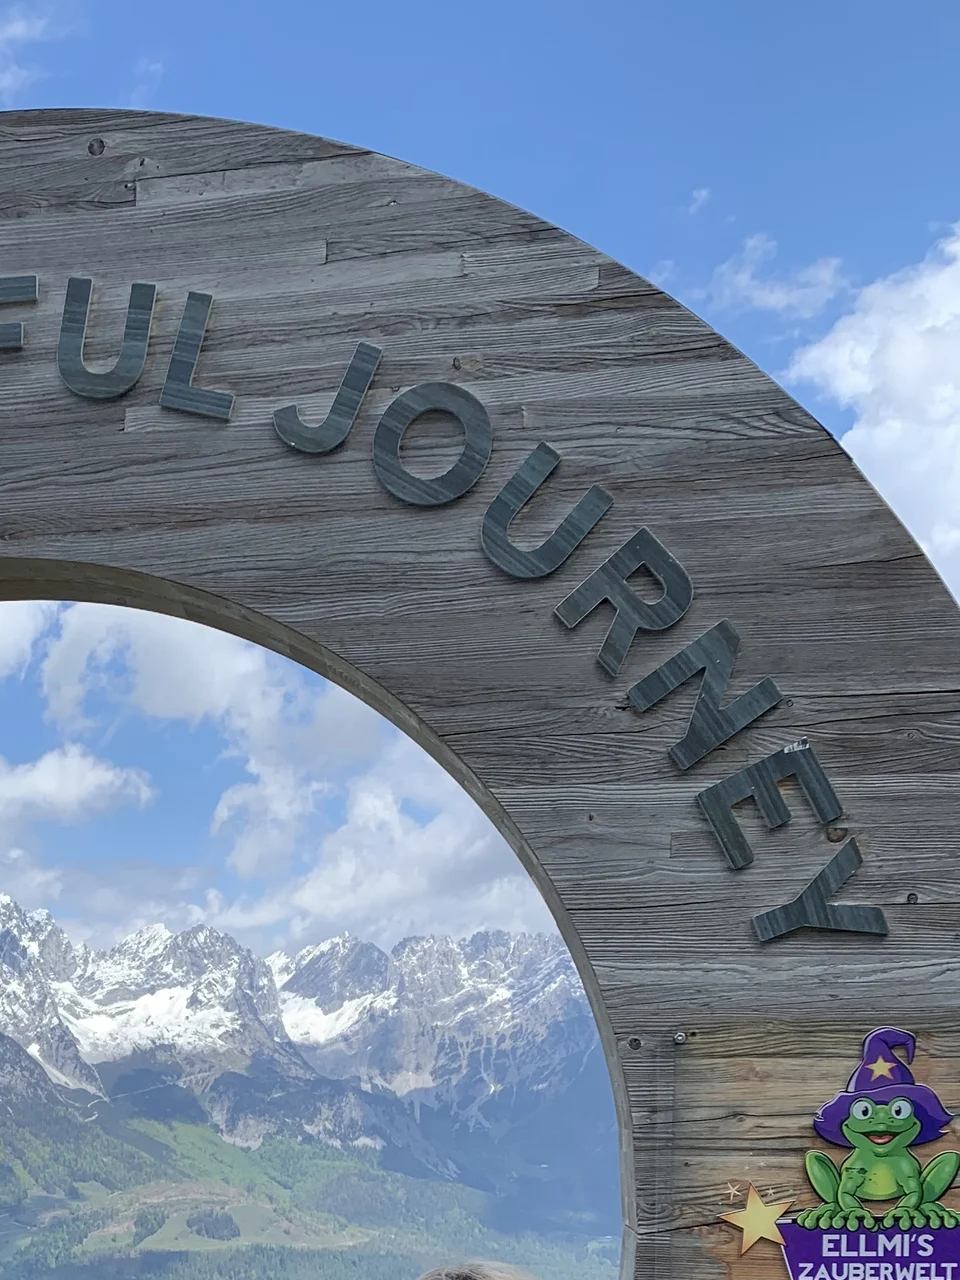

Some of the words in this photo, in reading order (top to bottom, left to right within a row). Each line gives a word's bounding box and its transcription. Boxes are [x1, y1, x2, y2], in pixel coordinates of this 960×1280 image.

[273, 341, 889, 942] JOURNEY
[821, 1234, 935, 1257] ELLMI'S
[797, 1262, 959, 1280] ZAUBERWELT
